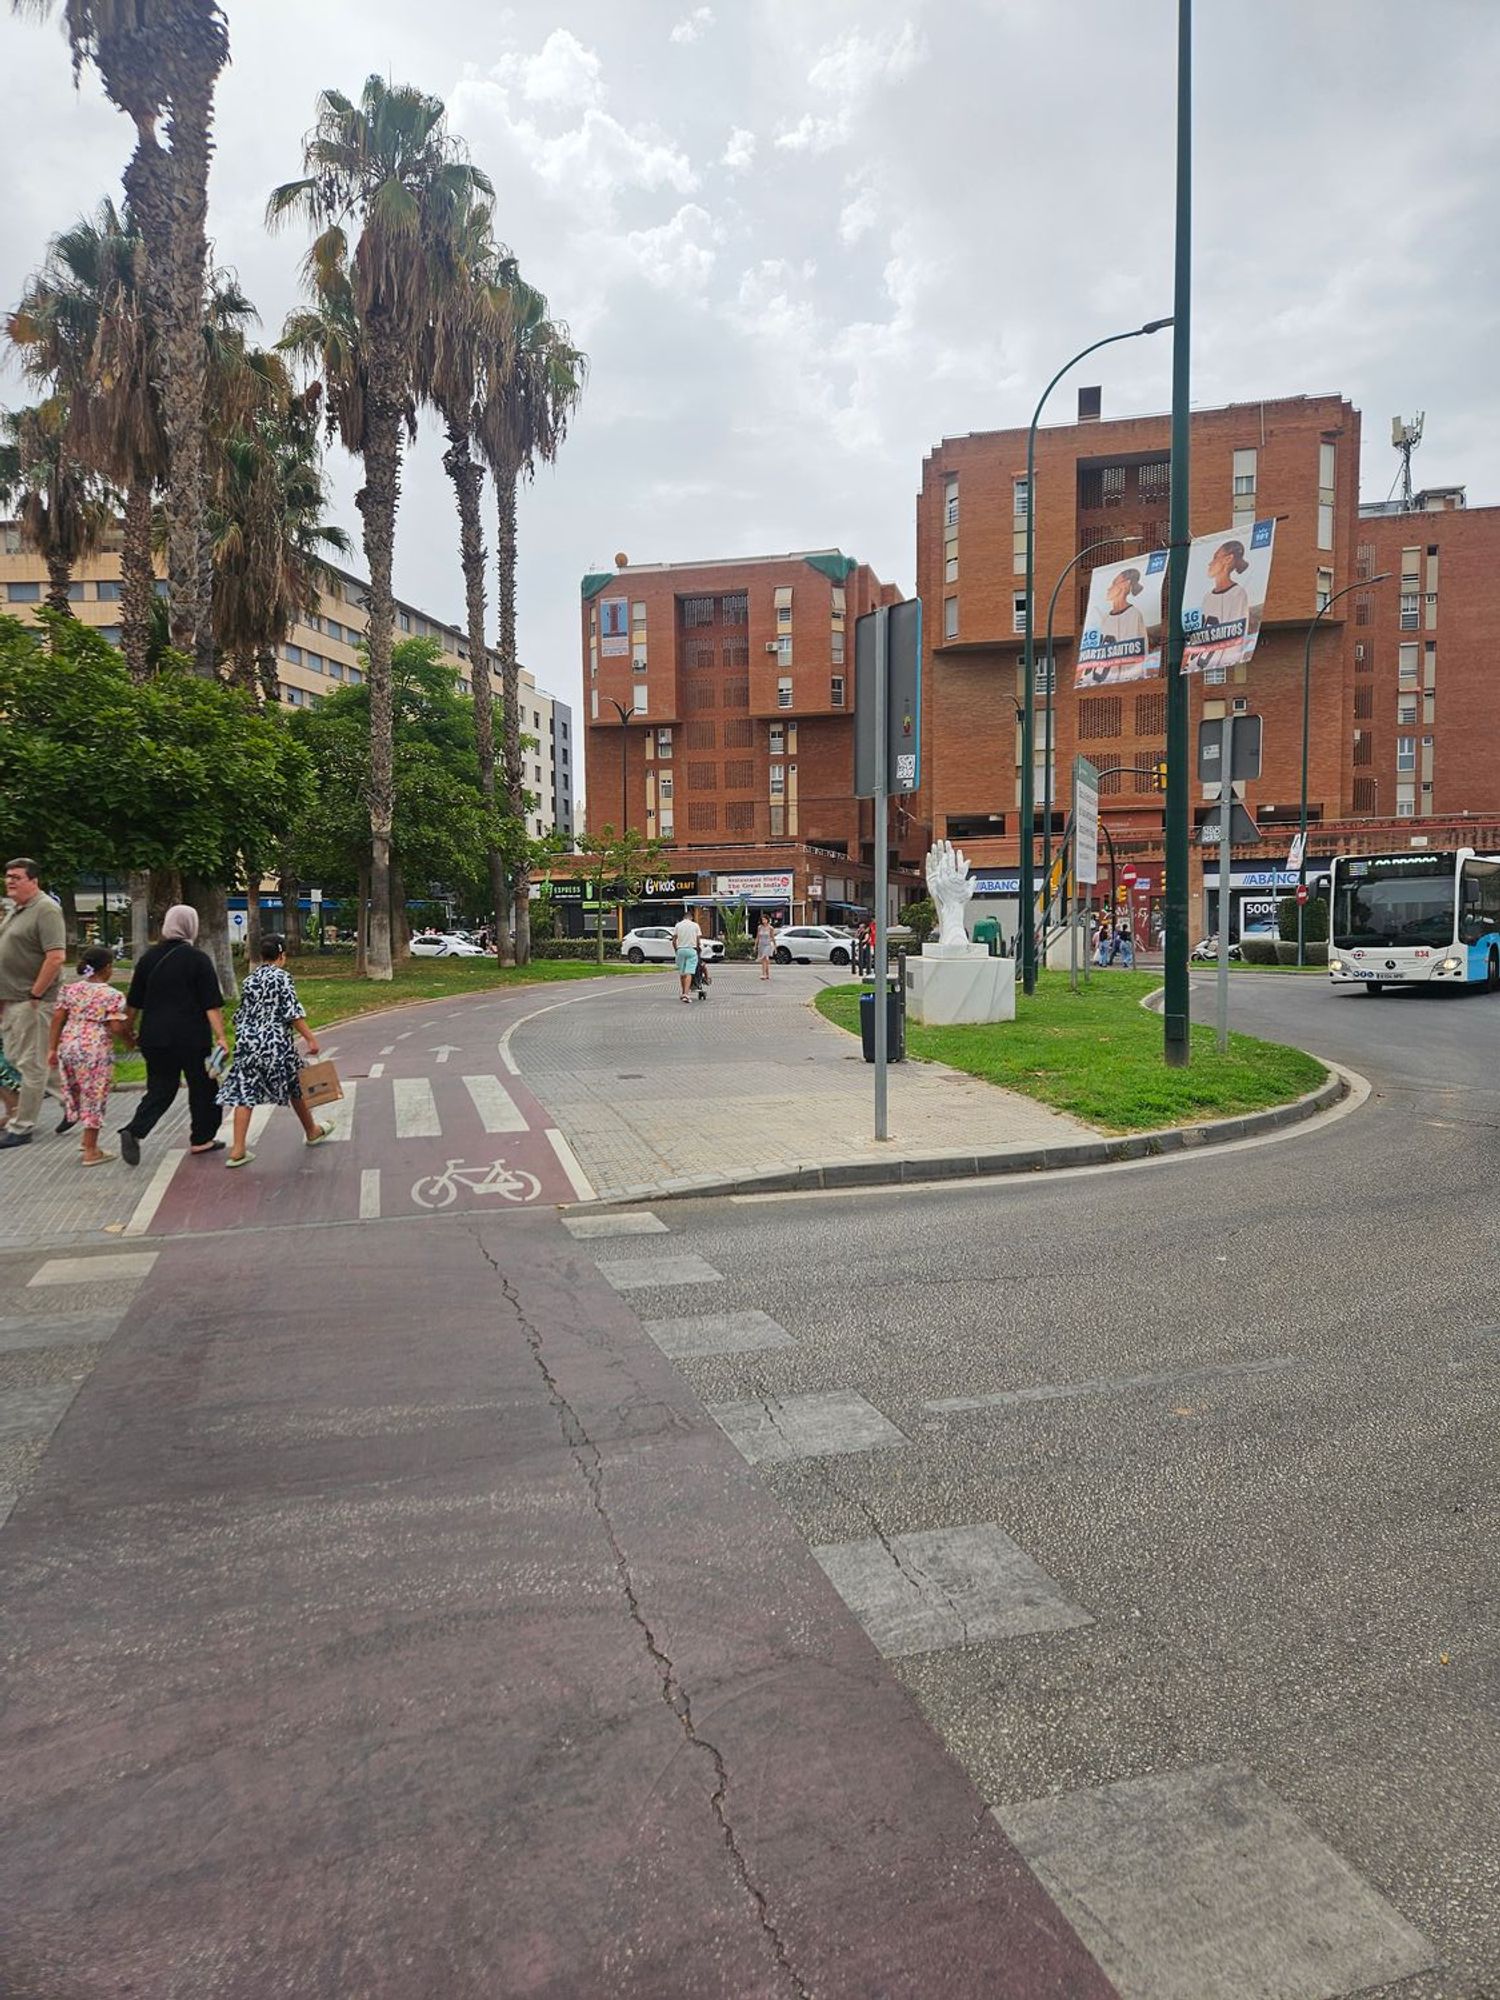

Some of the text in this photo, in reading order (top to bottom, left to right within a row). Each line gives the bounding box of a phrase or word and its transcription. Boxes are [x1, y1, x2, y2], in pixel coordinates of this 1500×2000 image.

[1210, 622, 1243, 641] SANTOS
[1106, 641, 1142, 657] SANTOS
[645, 877, 695, 895] GYROS CRAFT
